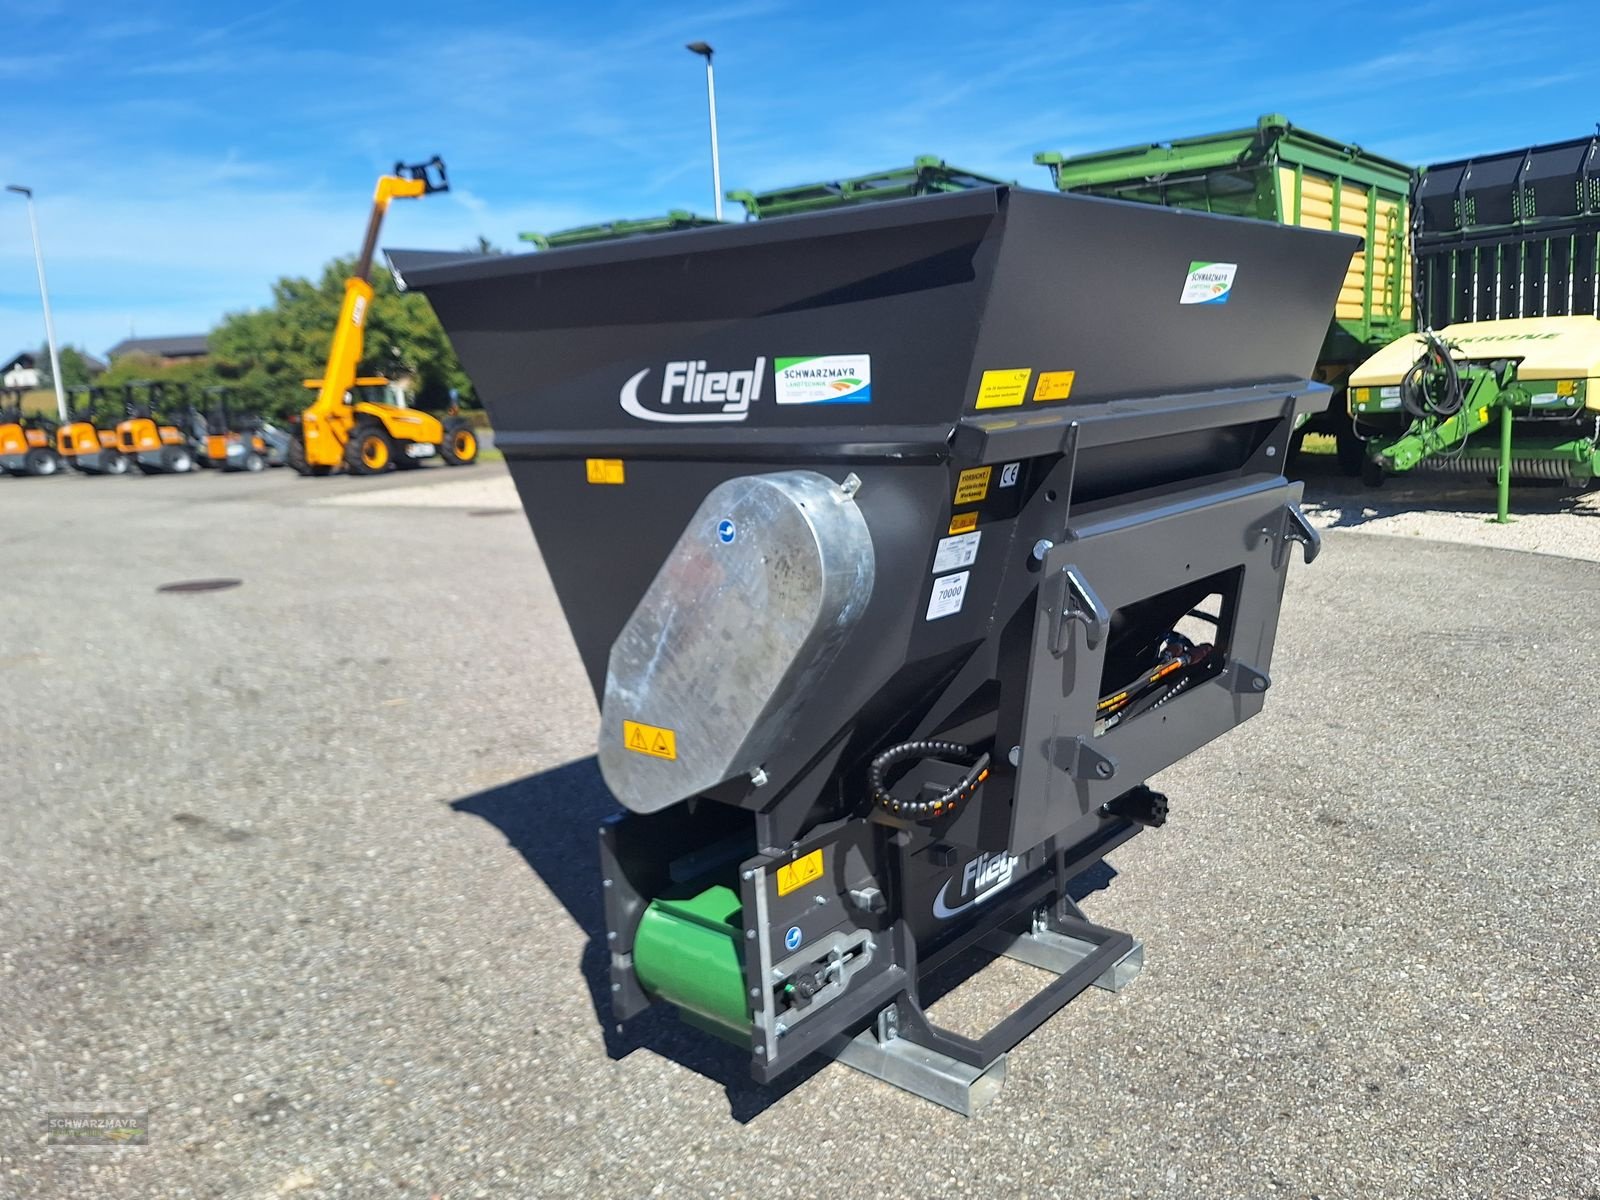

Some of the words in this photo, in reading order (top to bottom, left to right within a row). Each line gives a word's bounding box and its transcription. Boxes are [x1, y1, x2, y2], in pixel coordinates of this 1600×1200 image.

[784, 367, 855, 379] SCHWARZMAYR
[661, 356, 767, 412] Fliegl
[938, 585, 962, 601] 70000
